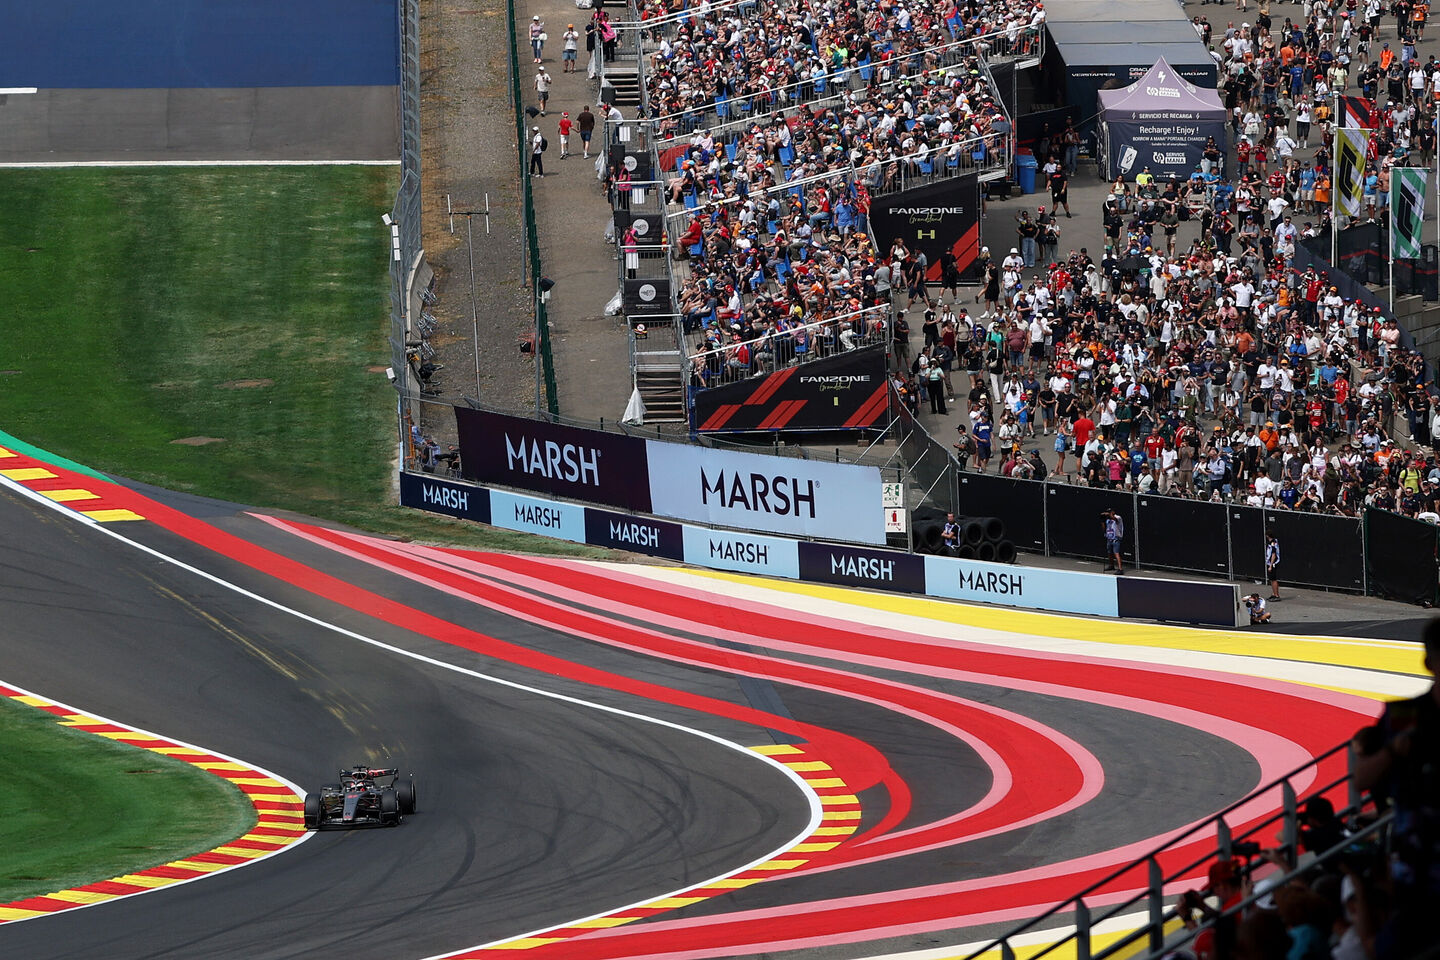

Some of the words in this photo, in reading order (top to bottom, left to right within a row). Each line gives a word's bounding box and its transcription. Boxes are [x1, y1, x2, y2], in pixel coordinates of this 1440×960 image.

[1139, 126, 1171, 135] Recharge
[1176, 126, 1195, 135] Enjoy
[889, 207, 963, 215] FANZONE
[909, 213, 943, 224] Grandstand
[918, 229, 935, 239] H
[800, 375, 871, 383] FANZONE
